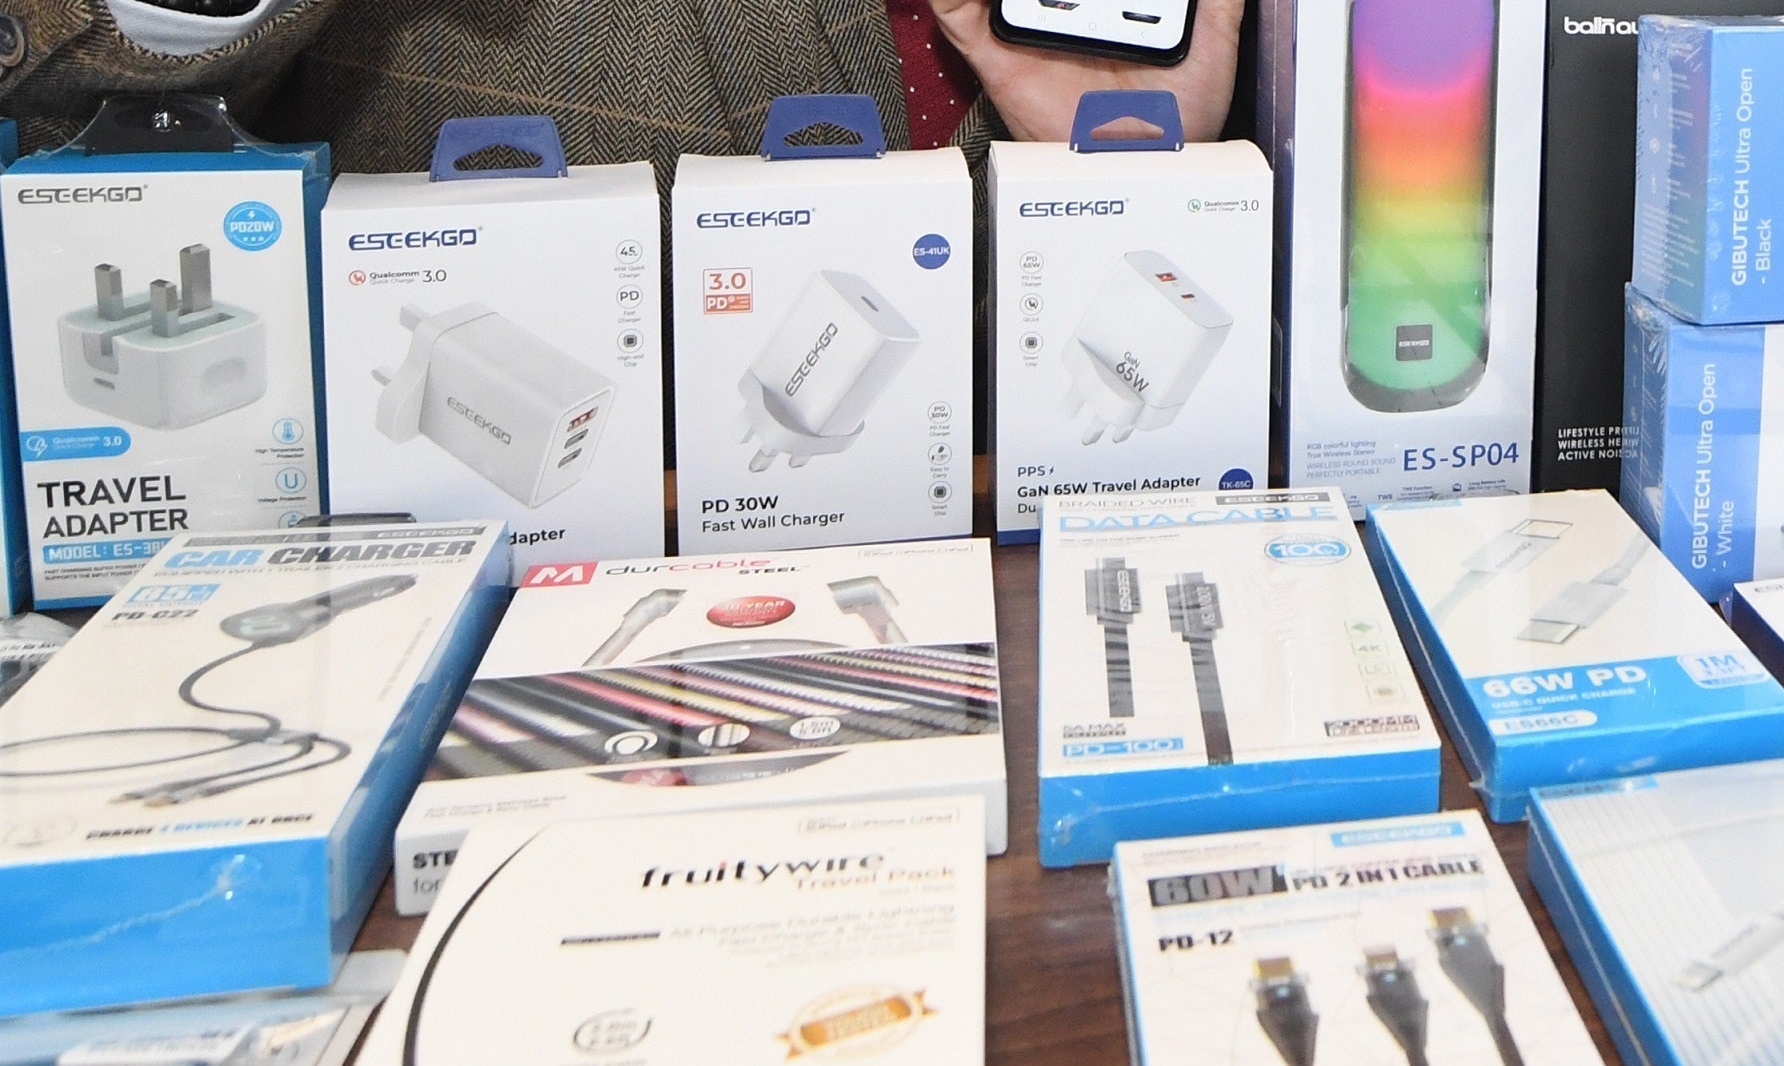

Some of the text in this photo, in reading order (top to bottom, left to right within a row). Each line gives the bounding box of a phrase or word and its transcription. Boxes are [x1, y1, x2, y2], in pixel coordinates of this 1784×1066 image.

[1731, 67, 1754, 286] GIBUTECH Ultra Open
[18, 187, 142, 204] ESEEKGO
[1020, 200, 1124, 217] ESEEKGO
[1240, 199, 1259, 212] 3.0
[229, 220, 275, 234] PD20W
[696, 210, 811, 229] ESEEKGO
[348, 228, 478, 251] ESEEKGO
[1756, 218, 1772, 272] Black
[913, 247, 950, 256] ES-41UK
[369, 269, 447, 283] Qualcomm 3.0
[708, 273, 747, 290] 3.0
[620, 291, 639, 301] PD
[706, 296, 728, 309] PD
[785, 322, 839, 398] ESEEKGO
[1123, 351, 1141, 369] GaN
[1115, 360, 1150, 393] 65W
[446, 396, 511, 446] ESEEKGO
[53, 435, 122, 446] Qualcomm 3.0
[1558, 427, 1605, 438] LIFESTYLE
[1558, 438, 1605, 449] WIRELESS
[1404, 442, 1520, 472] ES-SP04
[1558, 450, 1597, 461] ACTIVE
[1017, 464, 1045, 477] PPS
[1692, 363, 1717, 569] GIBUTECH Ultra Open
[37, 475, 186, 508] TRAVEL
[1017, 474, 1201, 499] GaN 65W Travel Adapter
[1222, 480, 1252, 489] TK-65C
[702, 495, 779, 514] PD 30W
[1149, 497, 1195, 506] WIRE
[43, 509, 190, 539] ADAPTER
[702, 511, 845, 533] Fast Wall Charger
[1060, 513, 1182, 531] DATA
[1186, 506, 1337, 523] CABLE
[1719, 500, 1734, 553] White
[509, 527, 566, 546] dapter
[49, 542, 108, 560] MODEL:
[163, 539, 477, 570] CAR CHARGER
[606, 558, 771, 576] durcable
[1483, 666, 1647, 698] 66W PD
[641, 852, 885, 890] fruitywire
[1151, 867, 1275, 905] 60W
